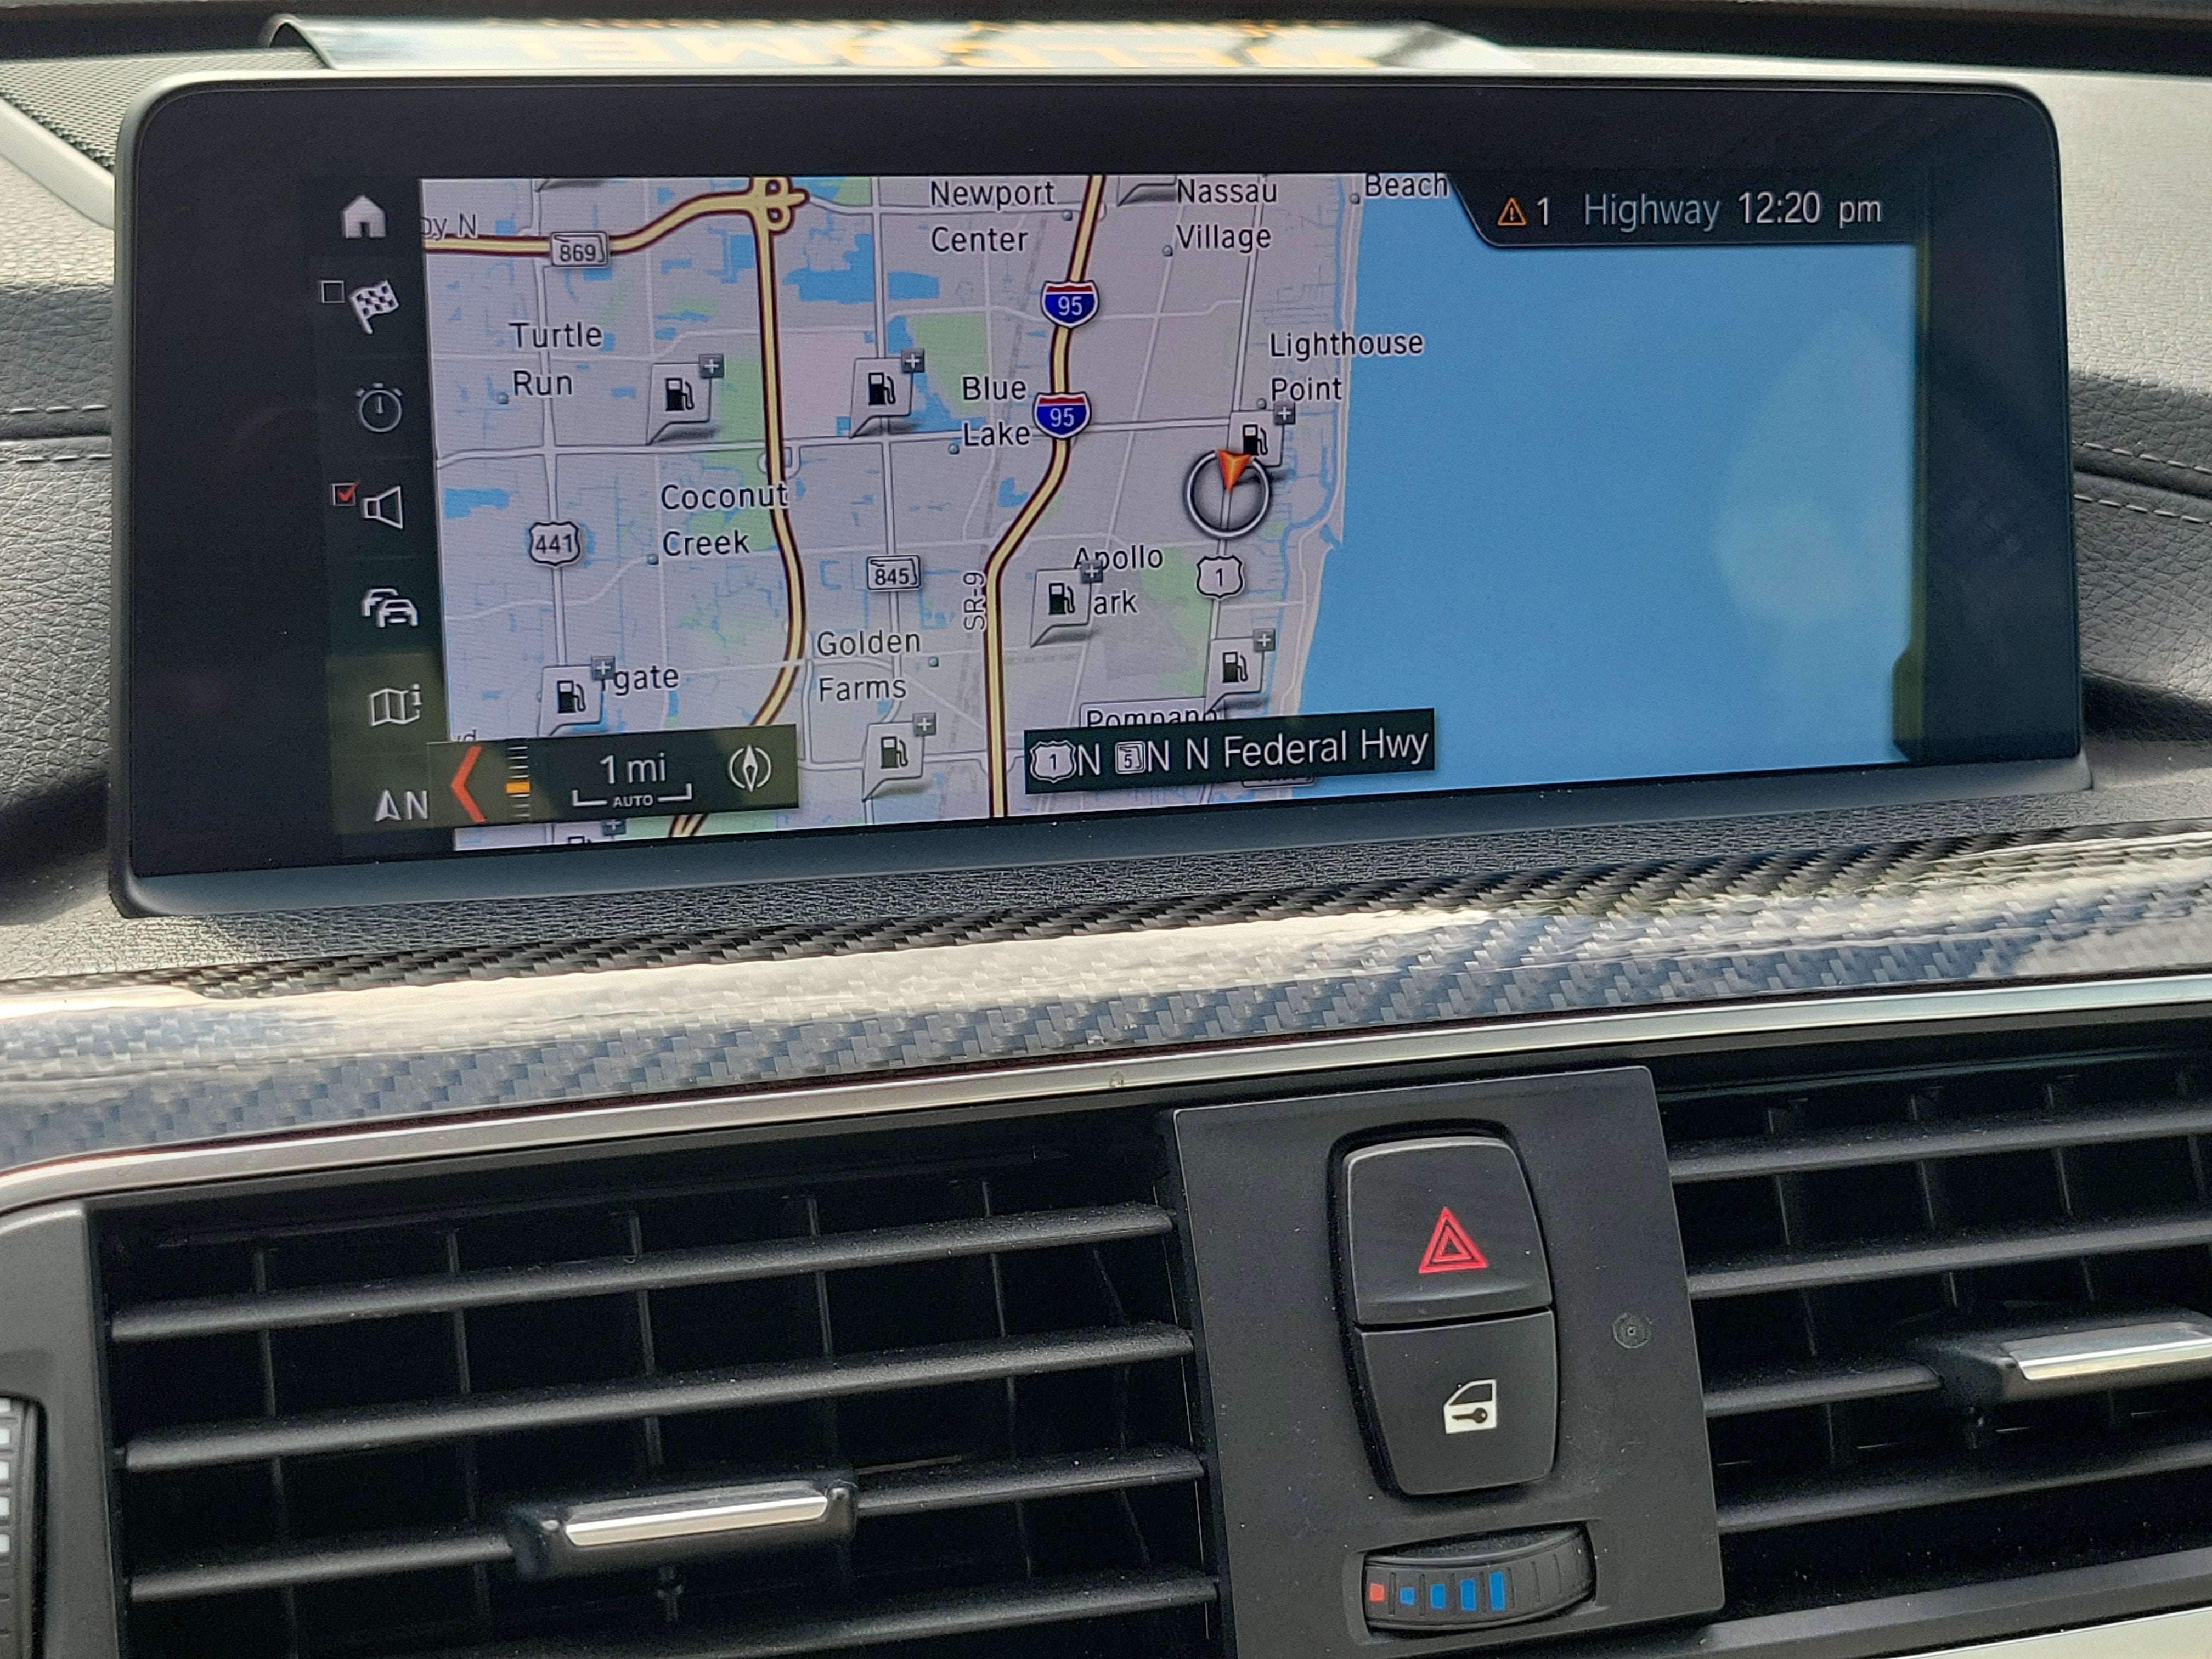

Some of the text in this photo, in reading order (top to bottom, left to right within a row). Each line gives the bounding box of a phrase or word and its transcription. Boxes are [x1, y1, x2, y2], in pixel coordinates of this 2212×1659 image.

[931, 180, 1054, 211] Newport
[1177, 179, 1277, 203] Nassau
[1365, 173, 1448, 196] Beach
[460, 213, 476, 236] N
[1537, 191, 1881, 233] 1 Highway 12:20 pm
[933, 227, 1028, 252] Center
[1177, 224, 1271, 252] Village
[560, 243, 596, 262] 869
[1058, 296, 1082, 317] 95
[509, 323, 602, 348] Turtle
[1271, 332, 1423, 362] Lighthouse
[514, 371, 572, 396] Run
[962, 377, 1026, 400] Blue
[1271, 377, 1341, 401] Point
[1050, 407, 1074, 428] 95
[963, 422, 1030, 447] Lake
[662, 484, 788, 510] Coconut
[535, 533, 572, 554] 441
[663, 529, 749, 556] Creek
[1074, 545, 1163, 571] Apollo
[875, 569, 909, 585] 845
[1216, 570, 1223, 586] 1
[963, 573, 985, 630] SR-9
[1094, 590, 1137, 614] ark
[817, 630, 920, 655] Golden
[820, 678, 906, 702] Farms
[1050, 727, 1429, 776] 1 N 5 N N Federal Hwy
[600, 753, 667, 785] 1 mi
[408, 791, 428, 820] N
[613, 794, 653, 808] AUTO
